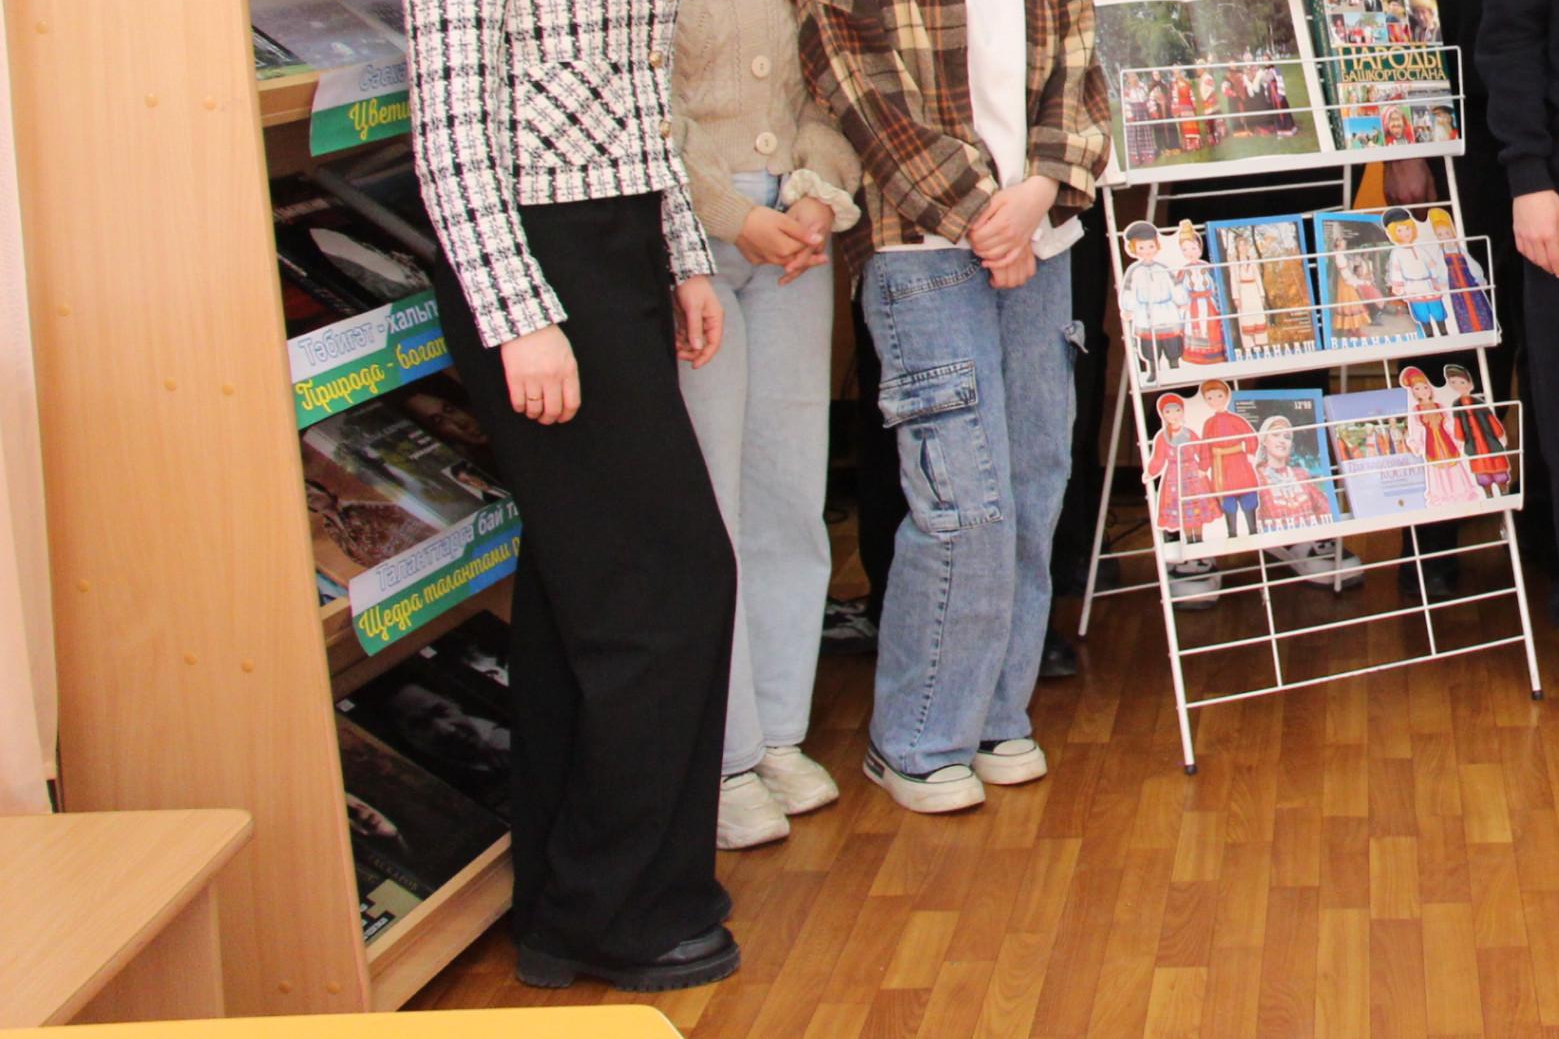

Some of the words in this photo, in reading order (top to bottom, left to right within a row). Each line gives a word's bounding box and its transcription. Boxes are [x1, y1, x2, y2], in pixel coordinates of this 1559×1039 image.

[1342, 68, 1447, 81] БАШКОРТОСТАНА
[295, 364, 384, 414] Природа
[358, 592, 423, 641] Щедра
[424, 543, 510, 600] талантами
